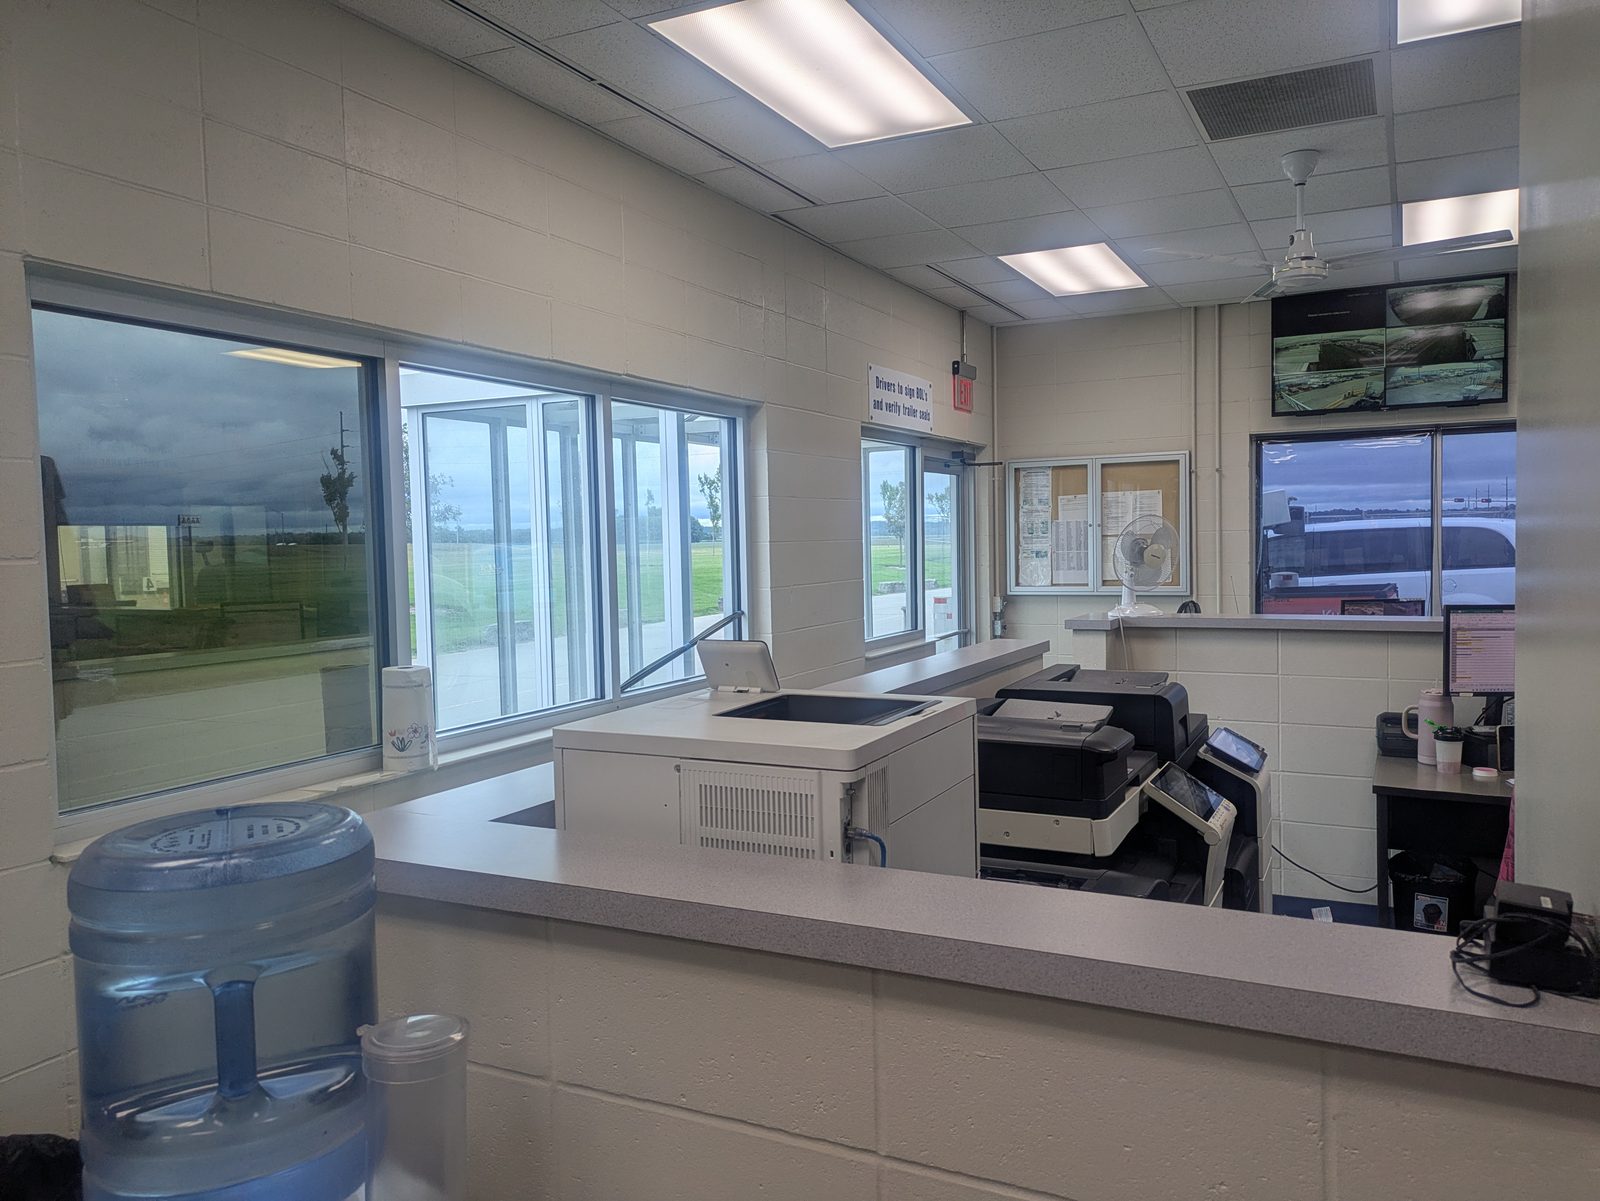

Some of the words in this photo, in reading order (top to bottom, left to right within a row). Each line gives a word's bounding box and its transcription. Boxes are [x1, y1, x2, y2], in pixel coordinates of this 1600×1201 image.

[876, 376, 896, 392] Drivers
[897, 381, 903, 394] to
[905, 385, 915, 399] sign
[873, 397, 883, 411] and
[885, 401, 901, 417] verify
[902, 403, 918, 418] trailer
[919, 409, 930, 421] seals
